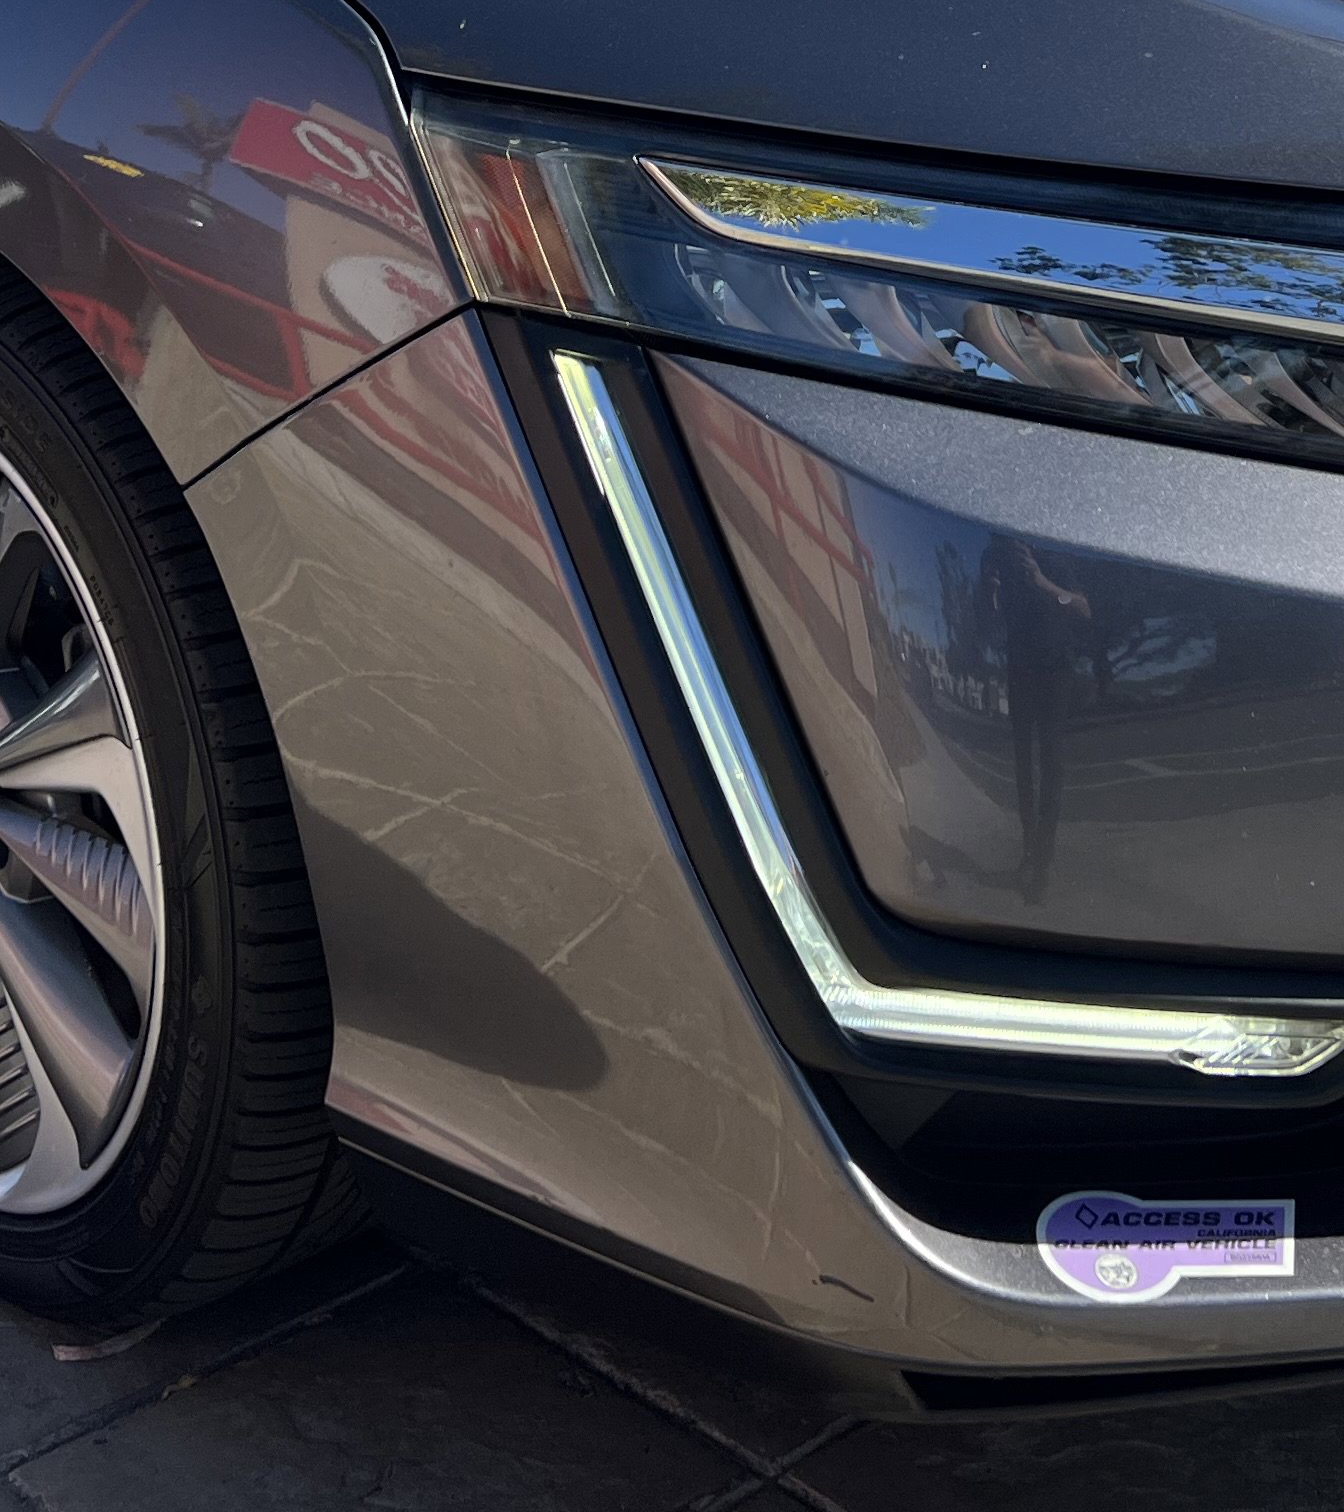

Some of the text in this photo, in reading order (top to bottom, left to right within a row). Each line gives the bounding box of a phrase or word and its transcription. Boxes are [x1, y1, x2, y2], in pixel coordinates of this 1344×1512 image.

[1100, 1211, 1275, 1227] ACCESS OK
[1197, 1228, 1277, 1238] CALIFORNIA
[1054, 1238, 1277, 1251] CLEAN AIR VEHICLE
